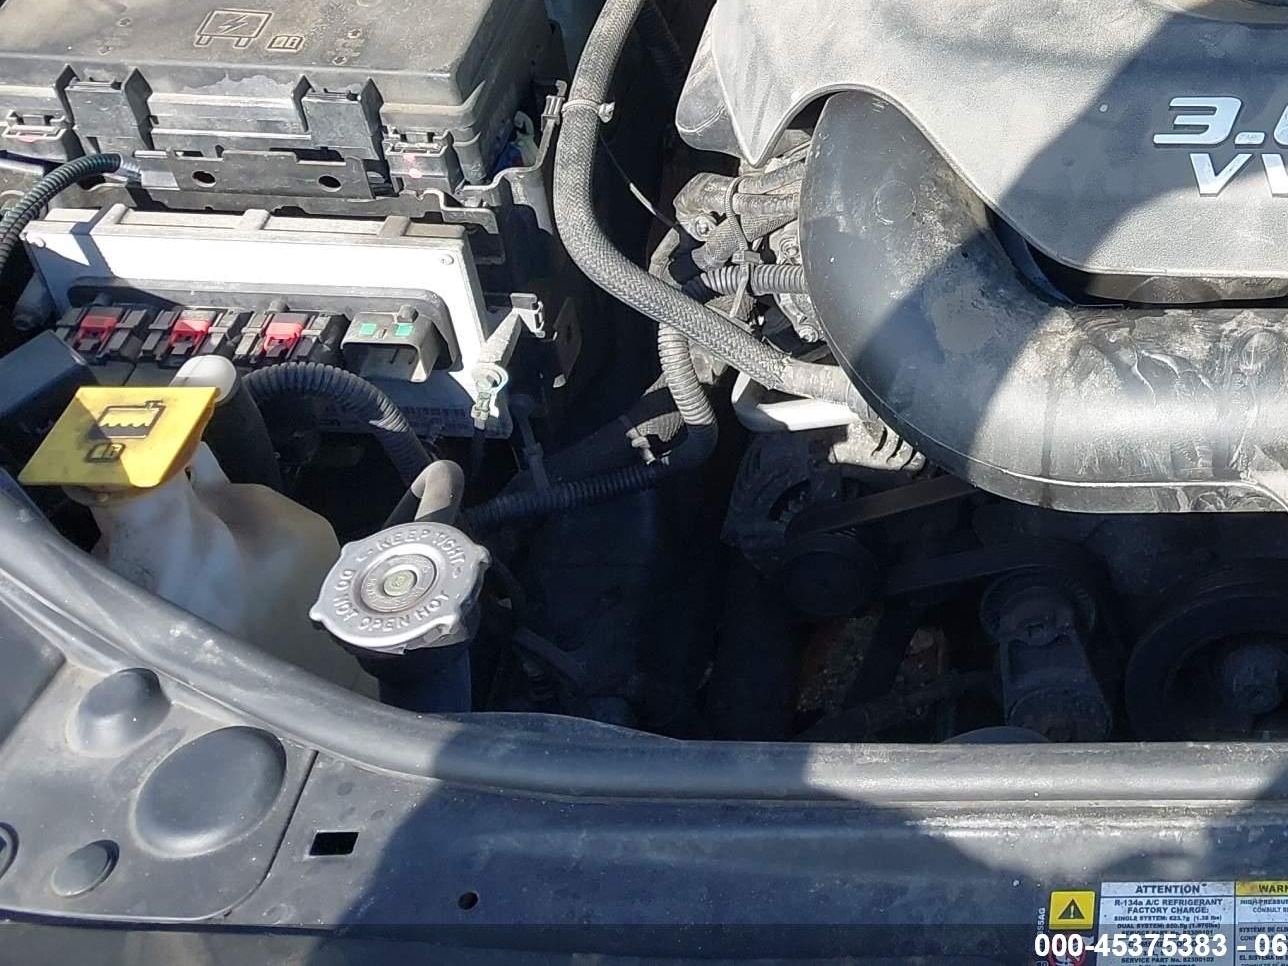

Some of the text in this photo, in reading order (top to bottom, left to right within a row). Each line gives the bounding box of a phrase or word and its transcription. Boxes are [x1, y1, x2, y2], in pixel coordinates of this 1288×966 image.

[376, 529, 431, 551] KEEP
[358, 614, 411, 632] OPEN
[414, 589, 449, 621] HOT
[1135, 884, 1200, 894] ATTENTION
[1114, 899, 1144, 907] R-134a
[1162, 898, 1223, 906] REFRIGERANT
